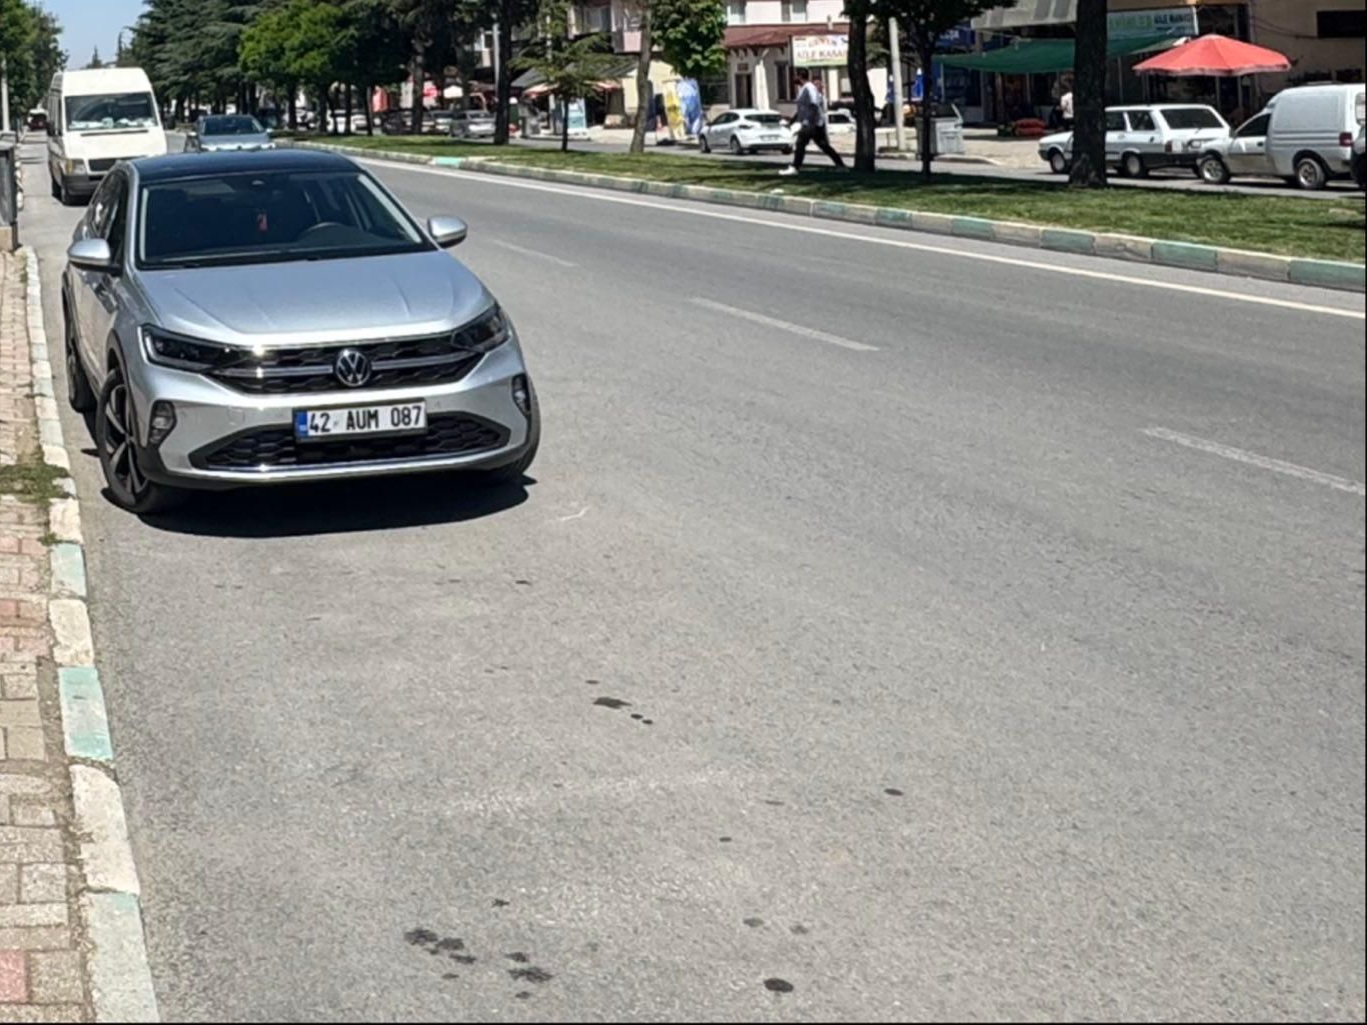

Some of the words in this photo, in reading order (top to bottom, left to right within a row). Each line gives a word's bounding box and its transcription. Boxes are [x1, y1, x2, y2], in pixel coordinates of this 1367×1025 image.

[309, 412, 331, 433] 42
[346, 409, 379, 430] AUM
[390, 405, 422, 427] 087
